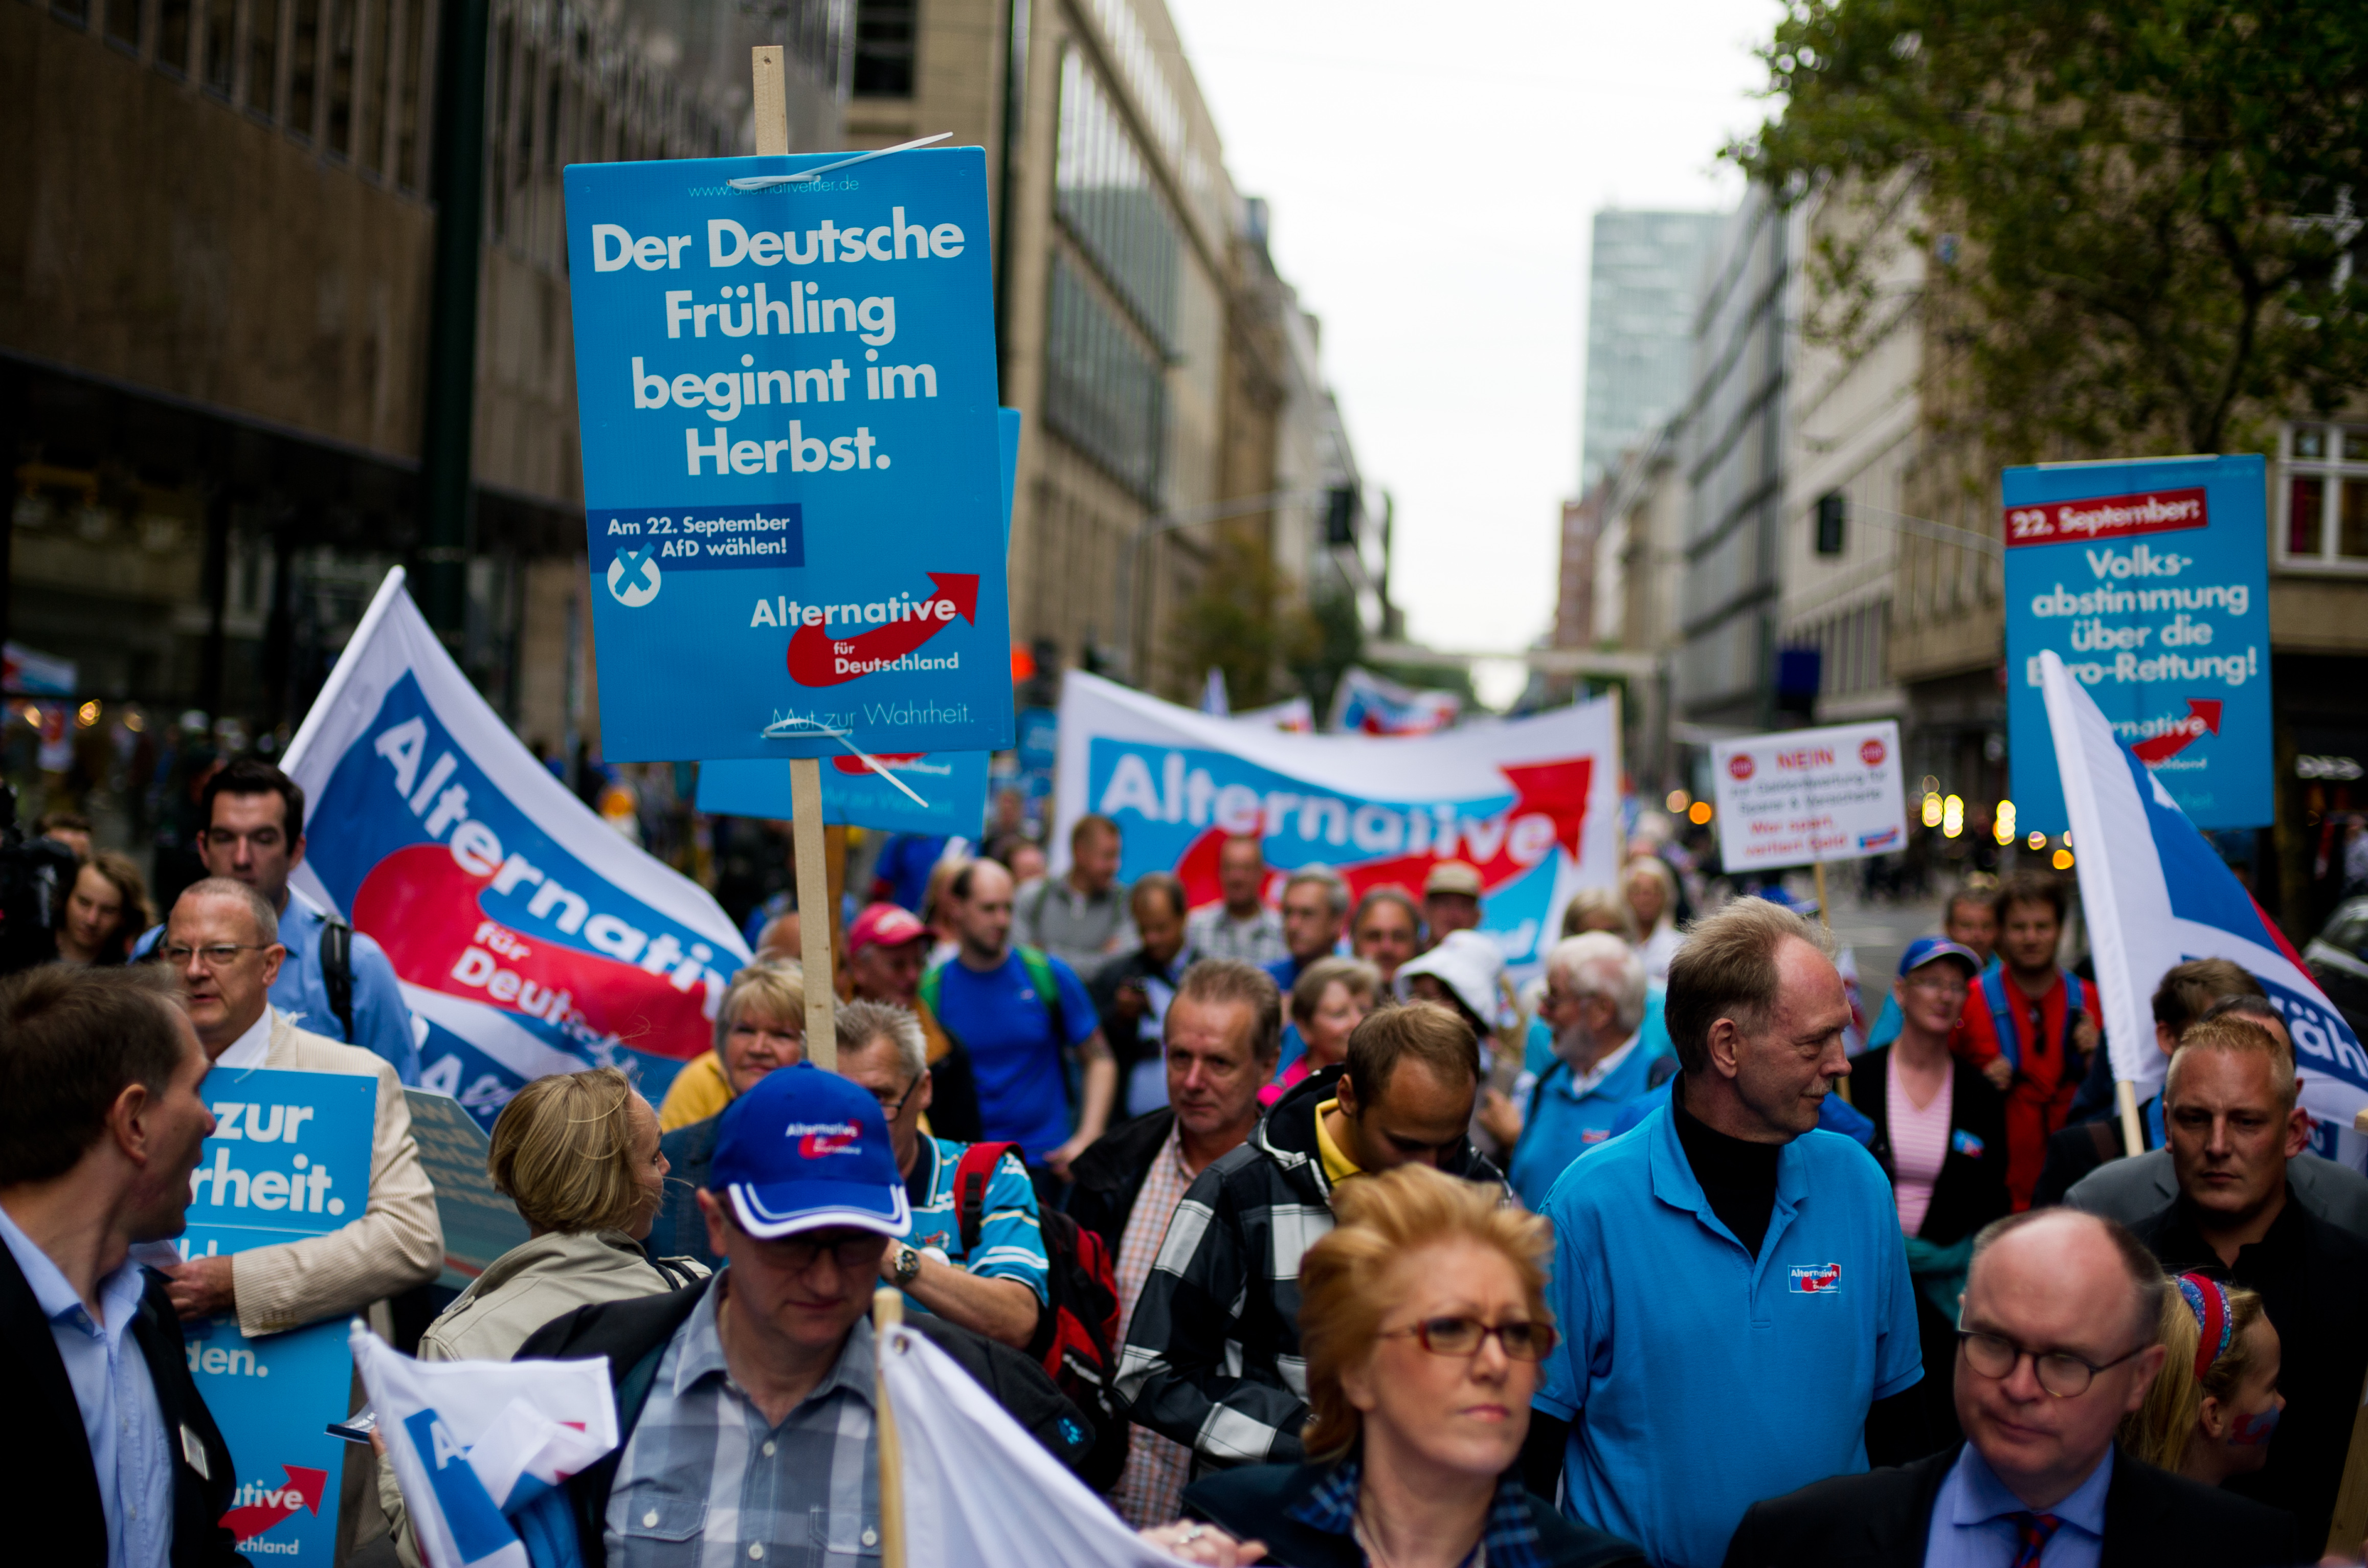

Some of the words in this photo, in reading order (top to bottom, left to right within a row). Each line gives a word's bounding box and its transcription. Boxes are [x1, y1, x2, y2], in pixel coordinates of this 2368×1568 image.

[592, 223, 691, 272] Der
[707, 206, 965, 267] Deutsche
[665, 281, 896, 346] Frühling
[632, 353, 850, 421] beginnt
[865, 348, 937, 400] im
[685, 419, 891, 476] Herbst.
[608, 519, 640, 535] Am
[646, 517, 678, 534] 22.
[683, 513, 790, 537] September
[2012, 512, 2054, 538] 22.
[661, 539, 700, 557] AfD
[706, 535, 788, 556] wählen!
[2086, 545, 2193, 579] Volks-
[750, 591, 956, 628] Alternative
[2031, 583, 2249, 617] abstimmung
[834, 642, 855, 655] für
[2071, 618, 2152, 651] über
[2160, 615, 2214, 647] die
[835, 652, 959, 674] Deutschland
[2026, 645, 2258, 687] Ero-Rettung!
[772, 708, 817, 730] Mut
[824, 711, 857, 728] zur
[863, 699, 975, 725] Wahrheit.
[1777, 747, 1835, 770] NEIN
[1099, 752, 1558, 866] Alternative
[475, 921, 531, 961] für
[208, 1101, 315, 1144] zur
[1791, 1268, 1837, 1278] Alternative
